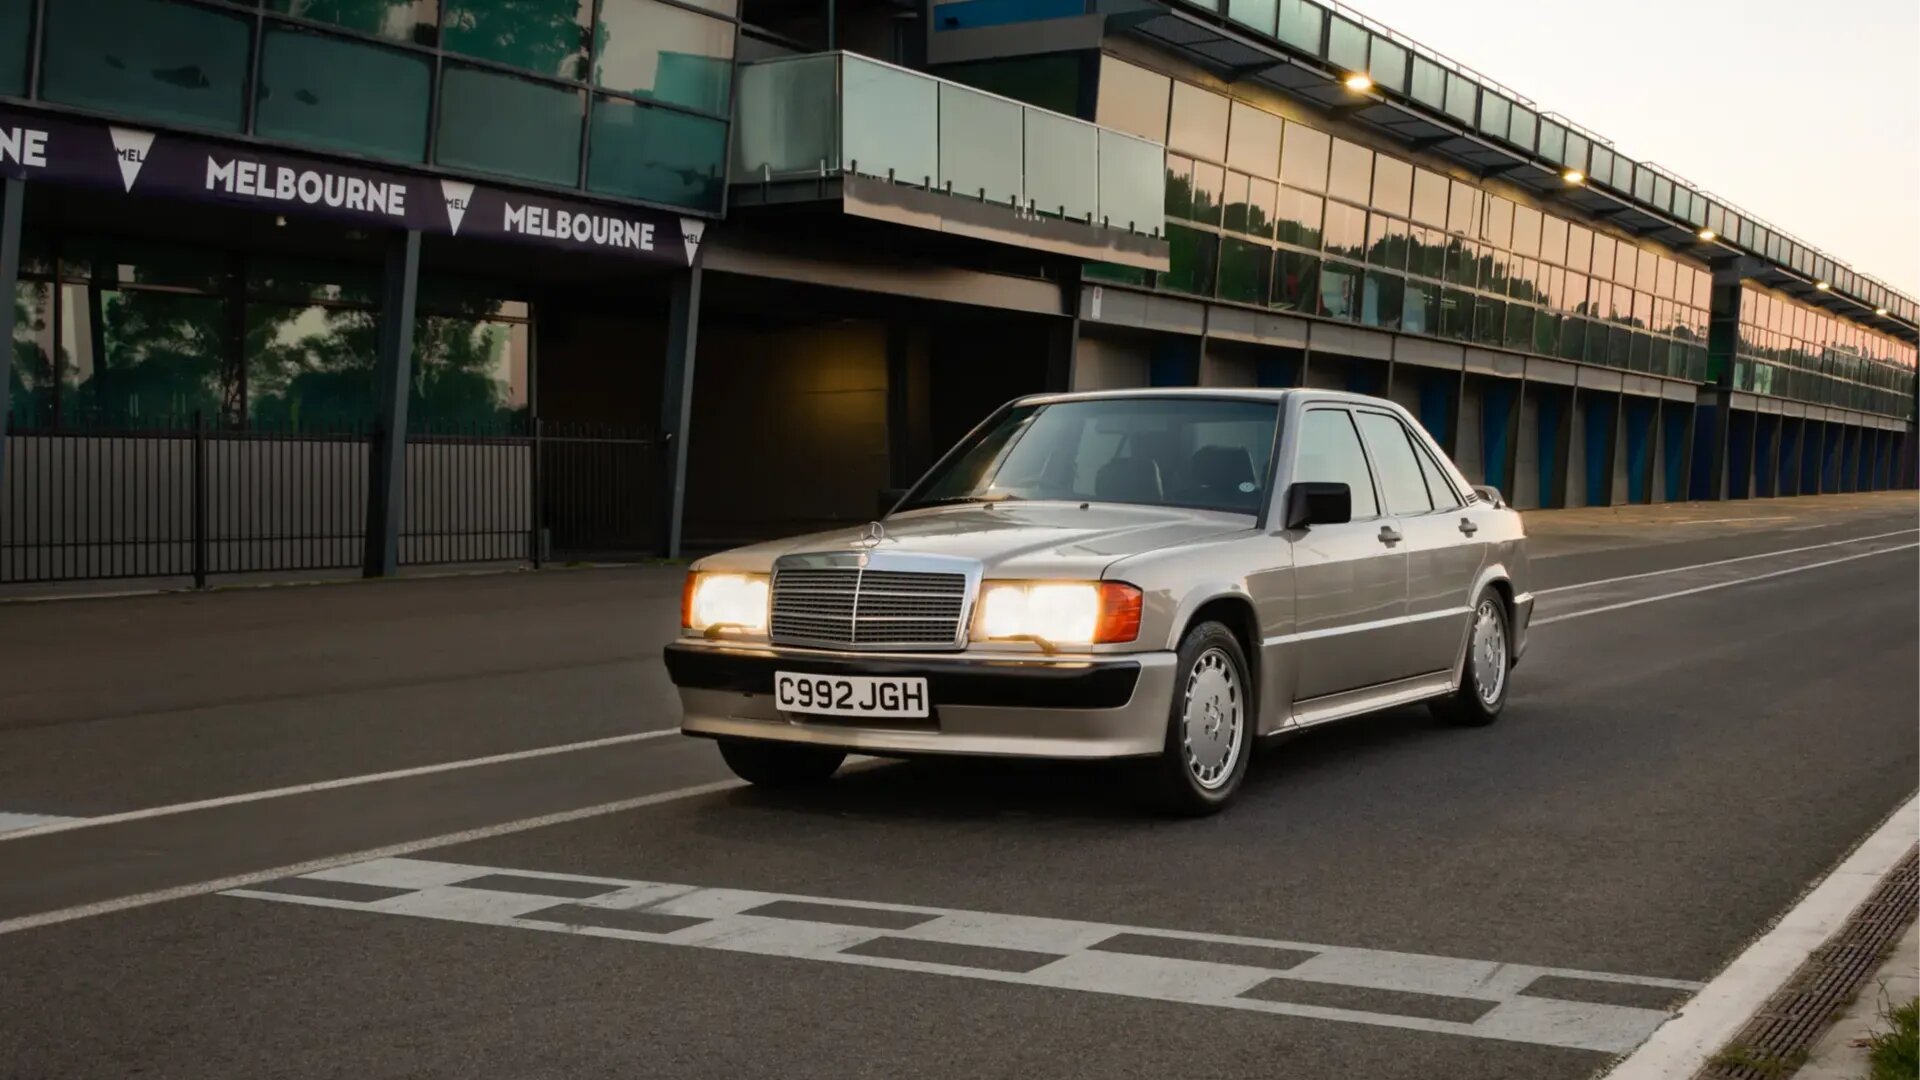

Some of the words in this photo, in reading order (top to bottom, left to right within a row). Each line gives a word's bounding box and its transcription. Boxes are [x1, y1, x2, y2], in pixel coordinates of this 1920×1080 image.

[115, 147, 145, 164] MEL
[205, 155, 407, 217] MELBOURNE
[445, 198, 469, 211] MEL
[503, 201, 655, 251] MELBOURNE
